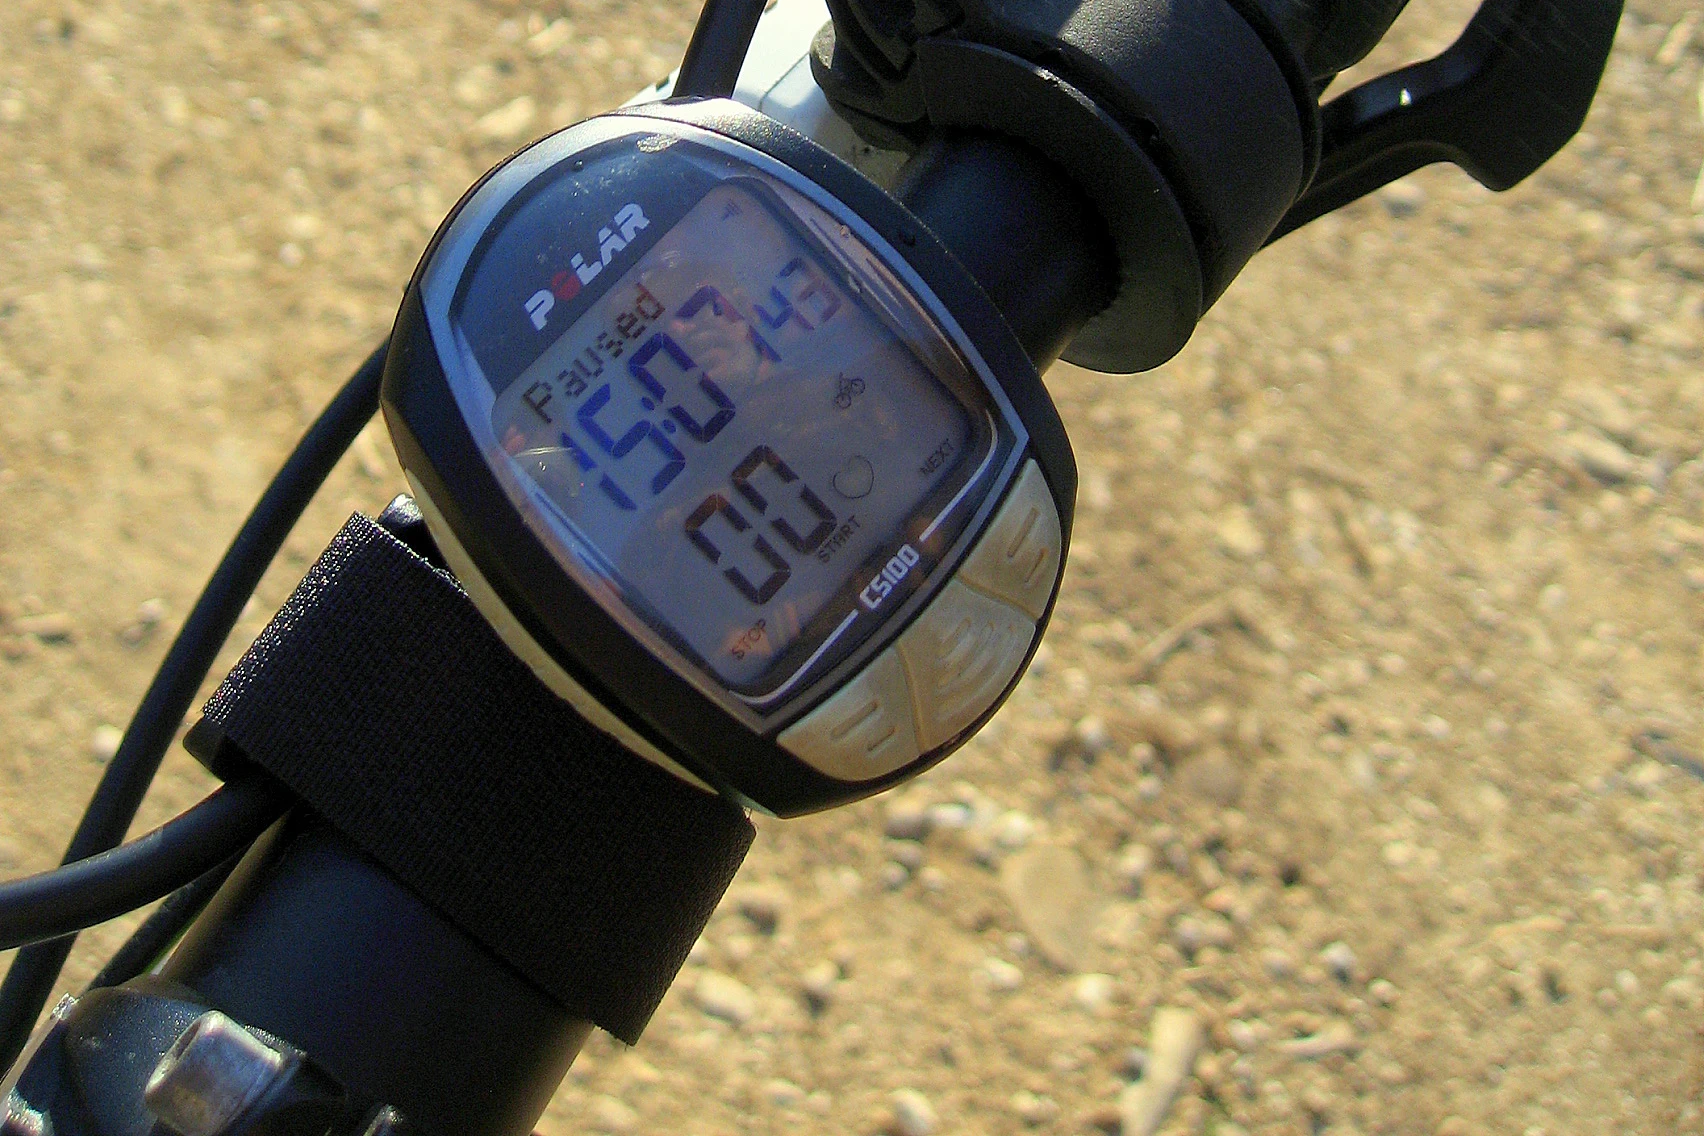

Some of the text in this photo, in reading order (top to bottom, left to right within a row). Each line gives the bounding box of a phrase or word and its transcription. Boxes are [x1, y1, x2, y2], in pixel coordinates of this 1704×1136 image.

[524, 202, 651, 332] POLAR
[522, 282, 666, 424] Paused
[918, 438, 955, 476] NEXT
[684, 444, 838, 605] 00
[818, 515, 861, 564] START
[859, 543, 921, 610] CS100
[731, 618, 768, 661] STOP
